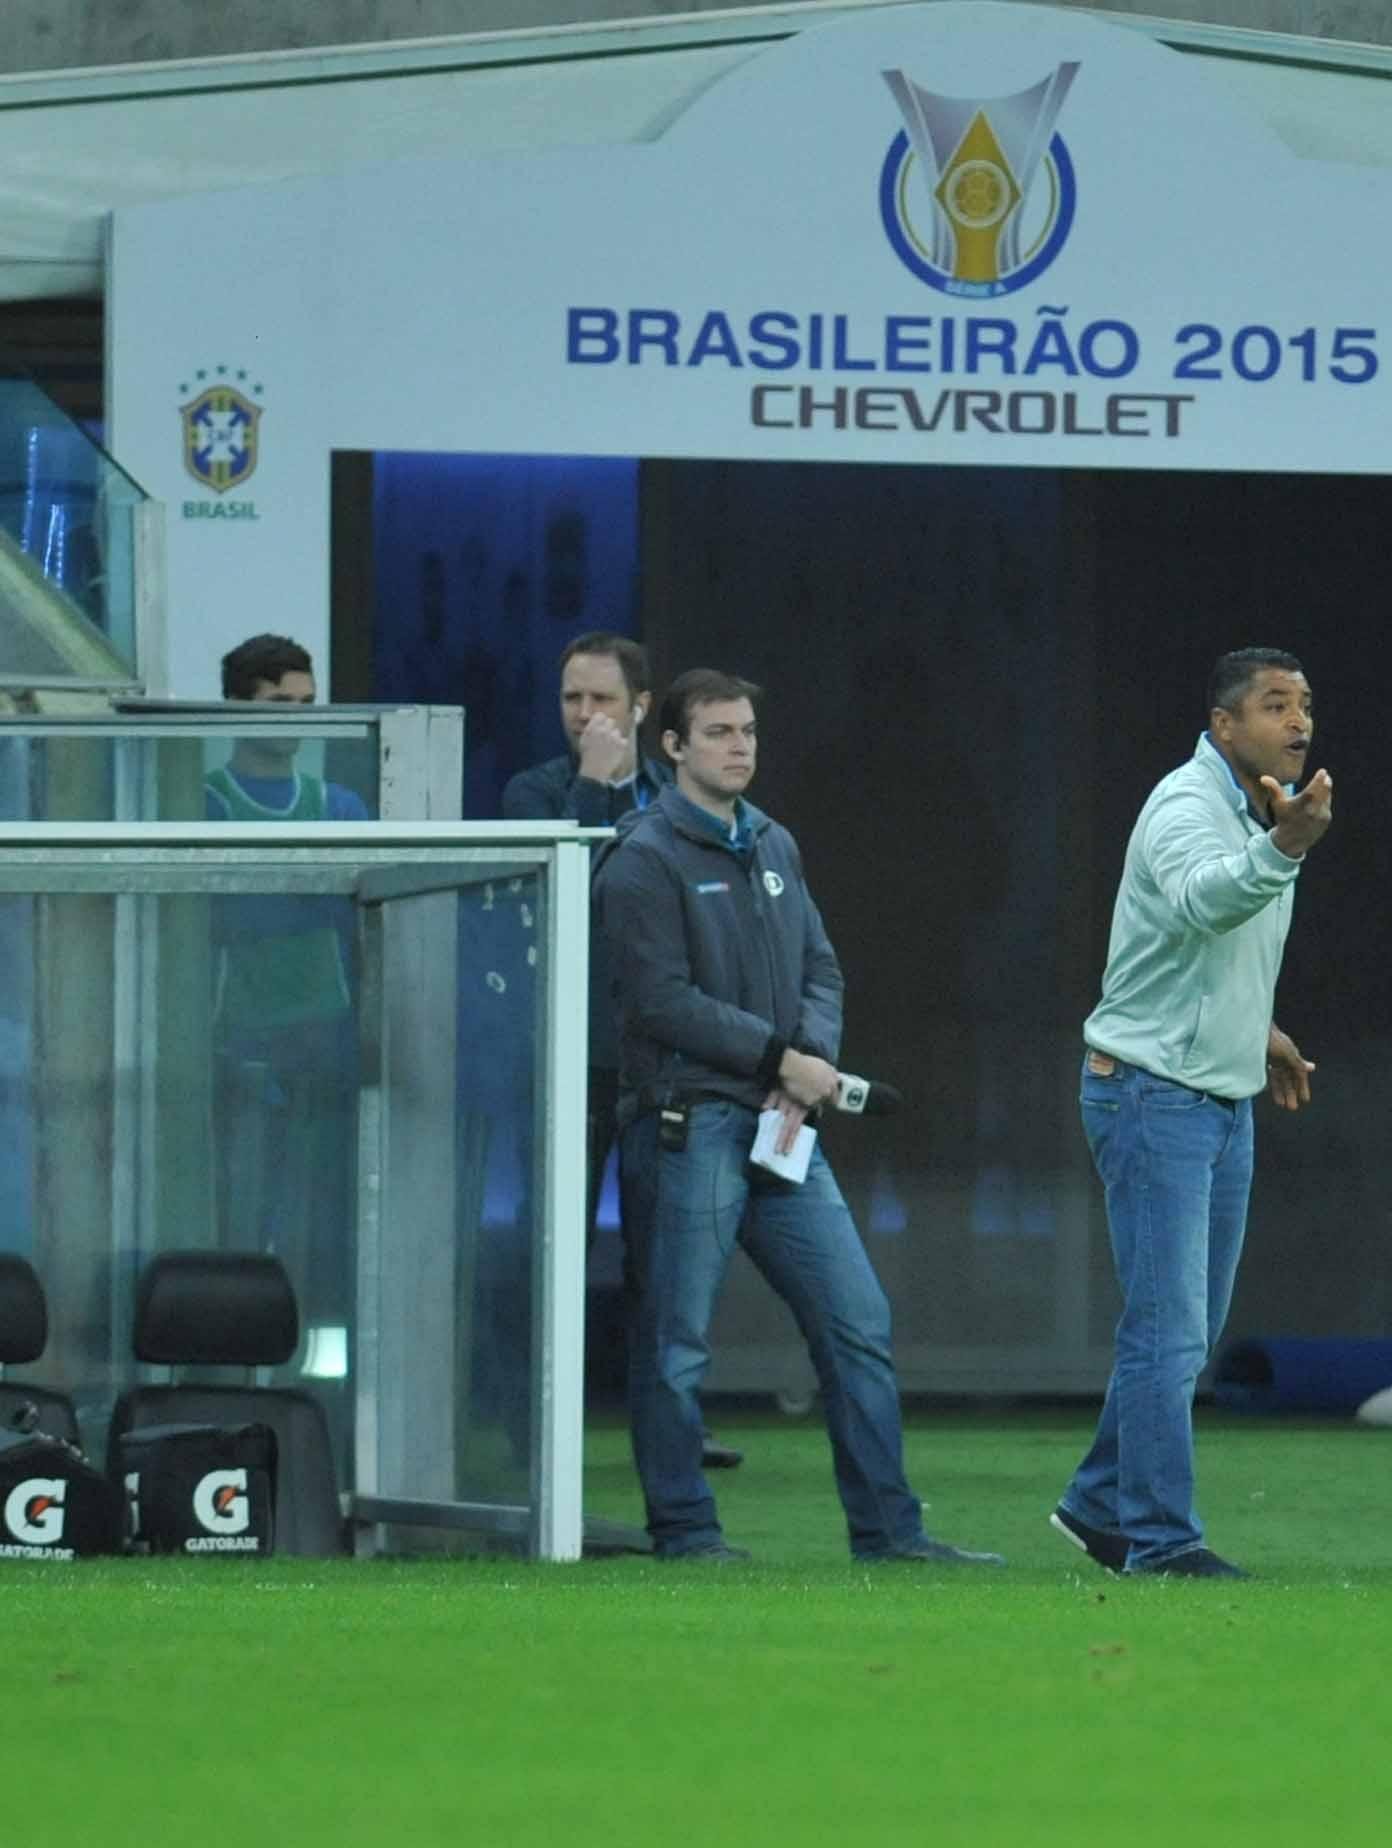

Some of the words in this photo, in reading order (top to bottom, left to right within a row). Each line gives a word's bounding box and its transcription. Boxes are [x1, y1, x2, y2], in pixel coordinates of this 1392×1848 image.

[566, 305, 1140, 379] BRASILEIRÃO
[1172, 323, 1379, 384] 2015
[750, 383, 1196, 437] CHEVROLET
[183, 501, 260, 519] BRASIL
[4, 1478, 66, 1544] G
[193, 1468, 249, 1535] G
